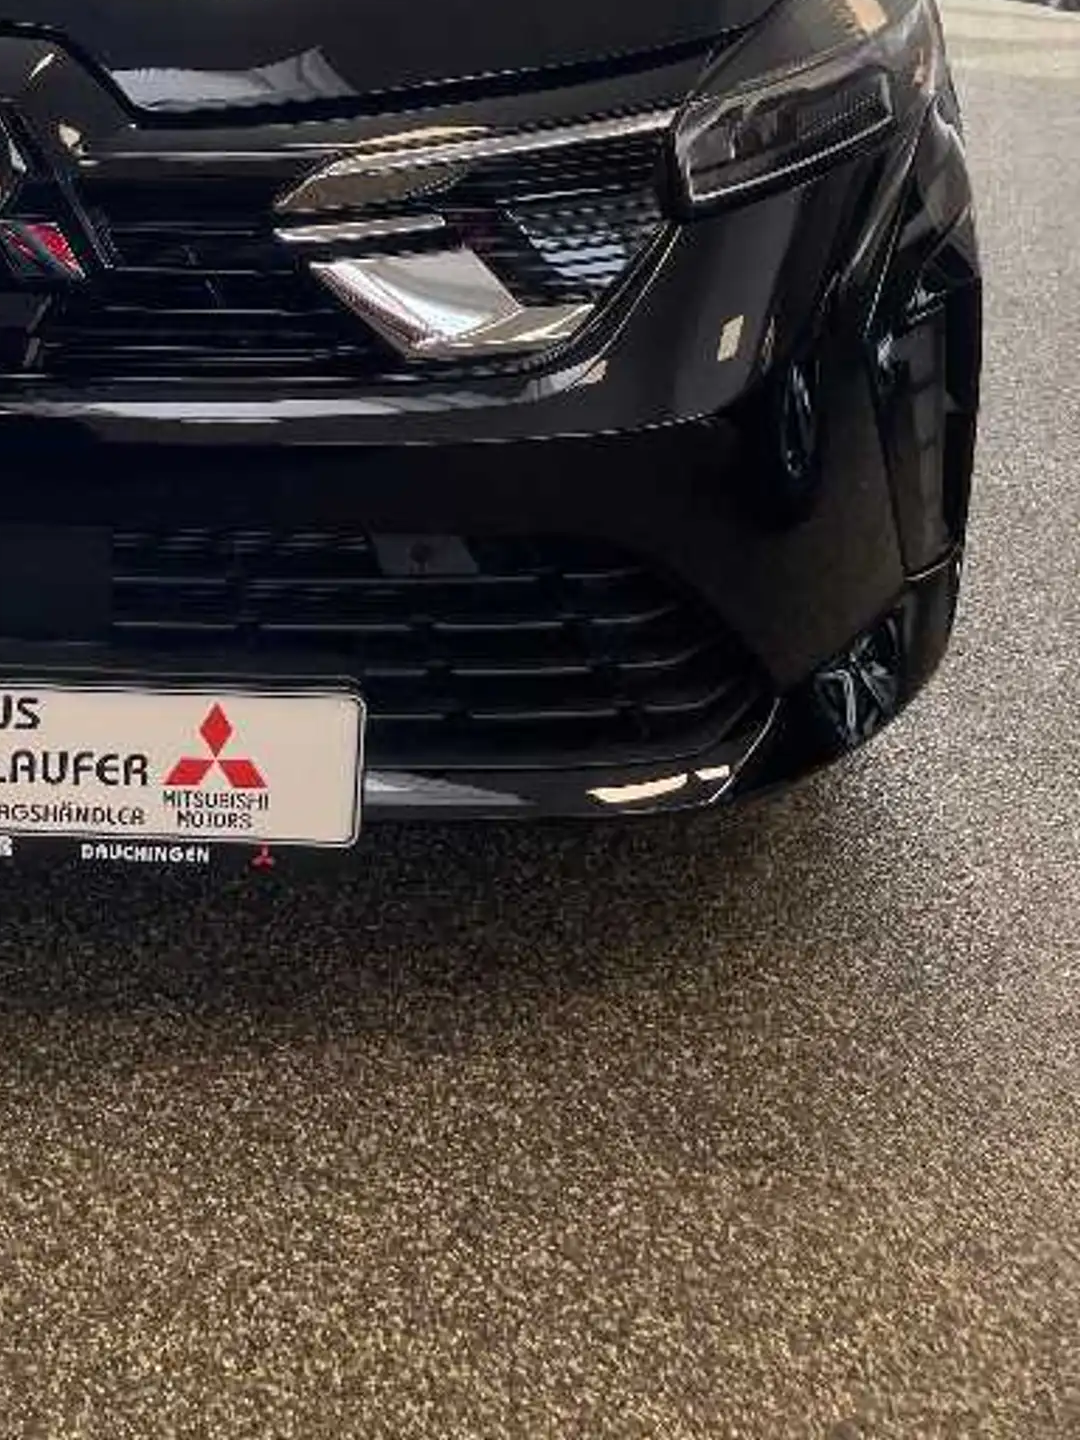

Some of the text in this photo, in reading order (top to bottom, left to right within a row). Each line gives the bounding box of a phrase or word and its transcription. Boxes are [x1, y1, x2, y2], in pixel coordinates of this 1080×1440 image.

[163, 790, 270, 812] MITSUBISHI
[176, 810, 253, 830] MOTORS
[81, 843, 210, 864] DAUCHINGEN
